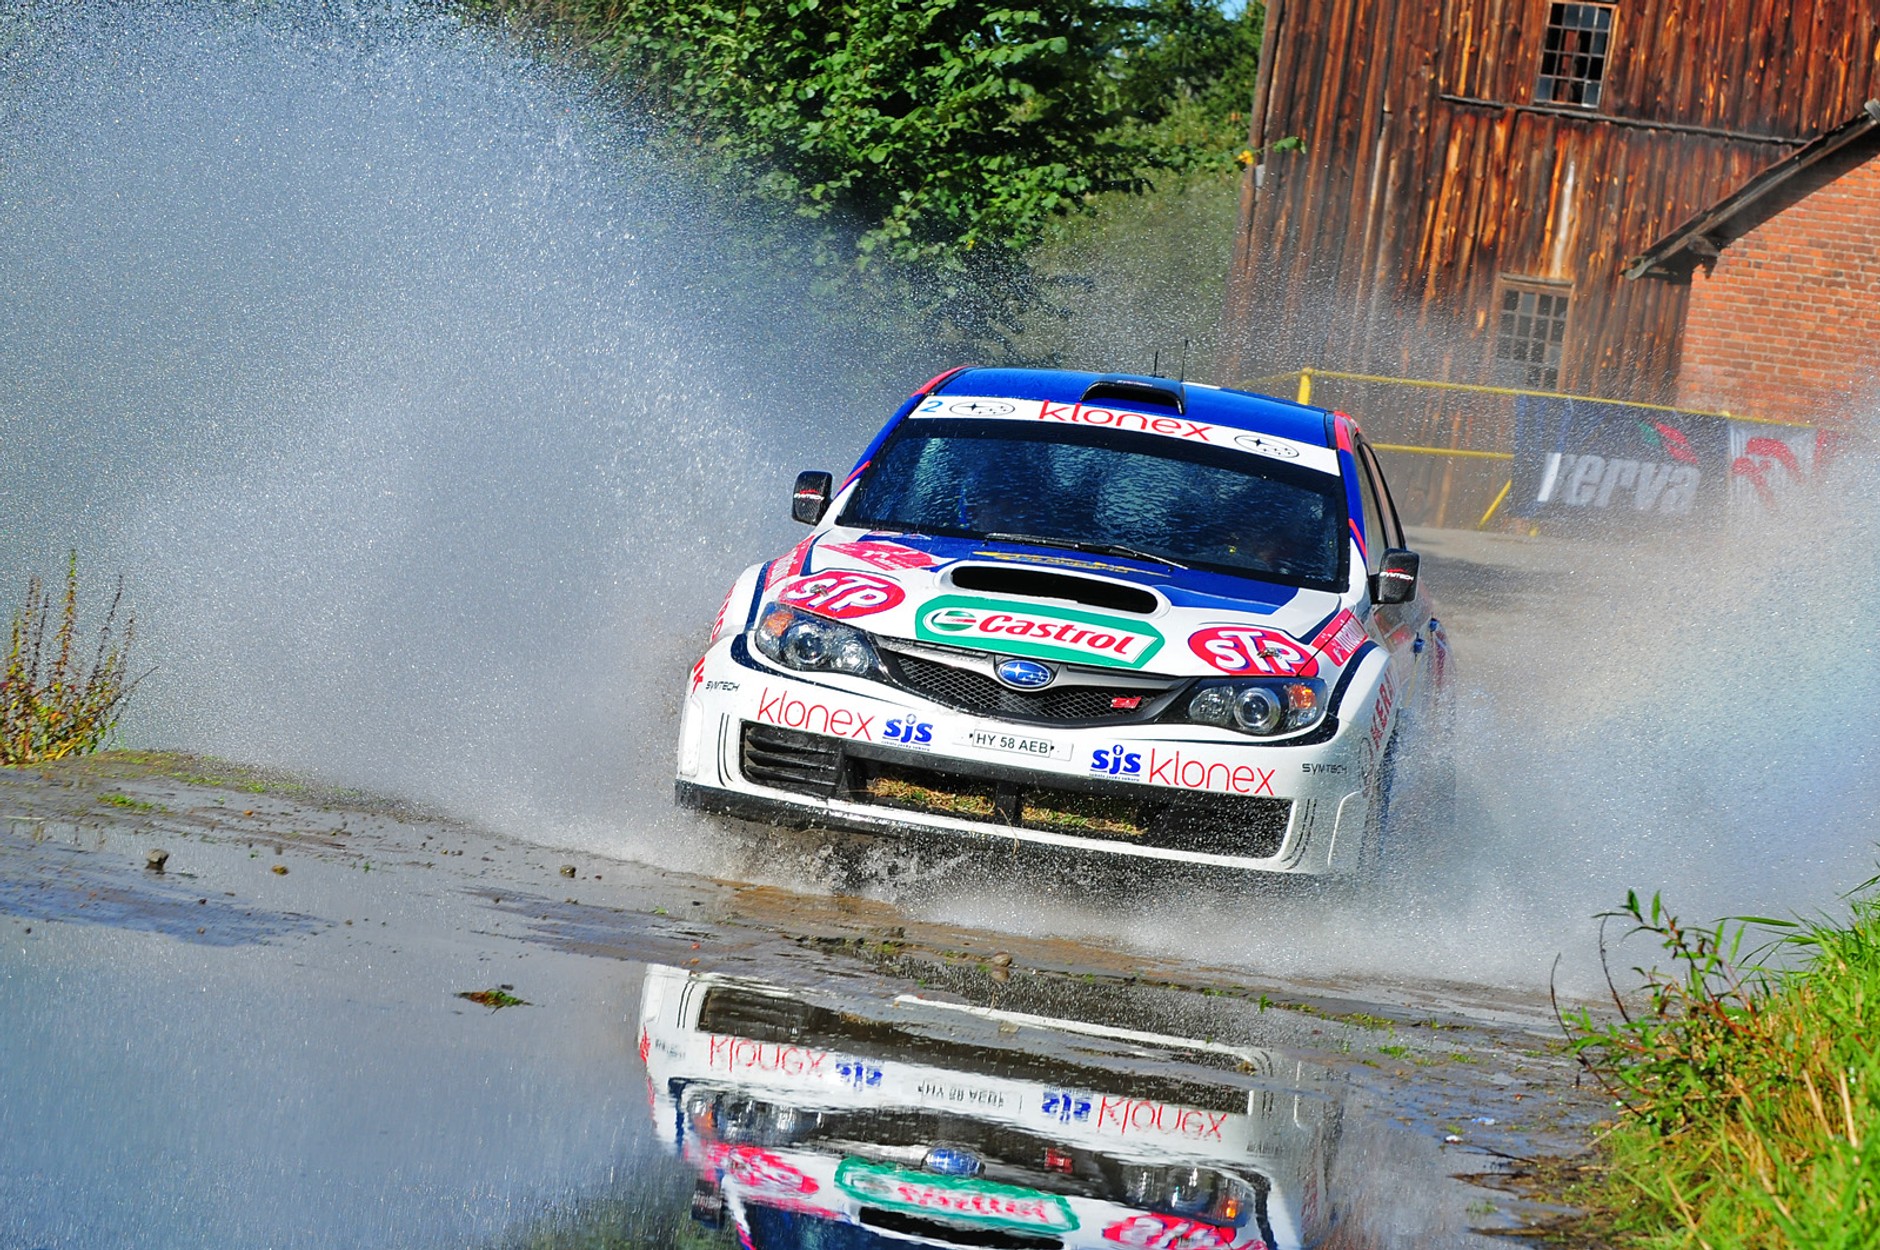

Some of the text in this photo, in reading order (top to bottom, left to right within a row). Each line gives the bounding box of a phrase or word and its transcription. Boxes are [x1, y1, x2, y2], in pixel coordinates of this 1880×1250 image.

[919, 400, 943, 413] 2
[1038, 400, 1212, 442] klonex
[786, 575, 889, 612] STP
[978, 614, 1135, 655] Castrol
[1204, 630, 1306, 674] STP
[757, 687, 876, 741] klonex
[882, 714, 934, 744] sjs
[976, 733, 1049, 754] HY 58 AEB
[1090, 744, 1142, 775] sjs
[1148, 747, 1277, 797] klonex
